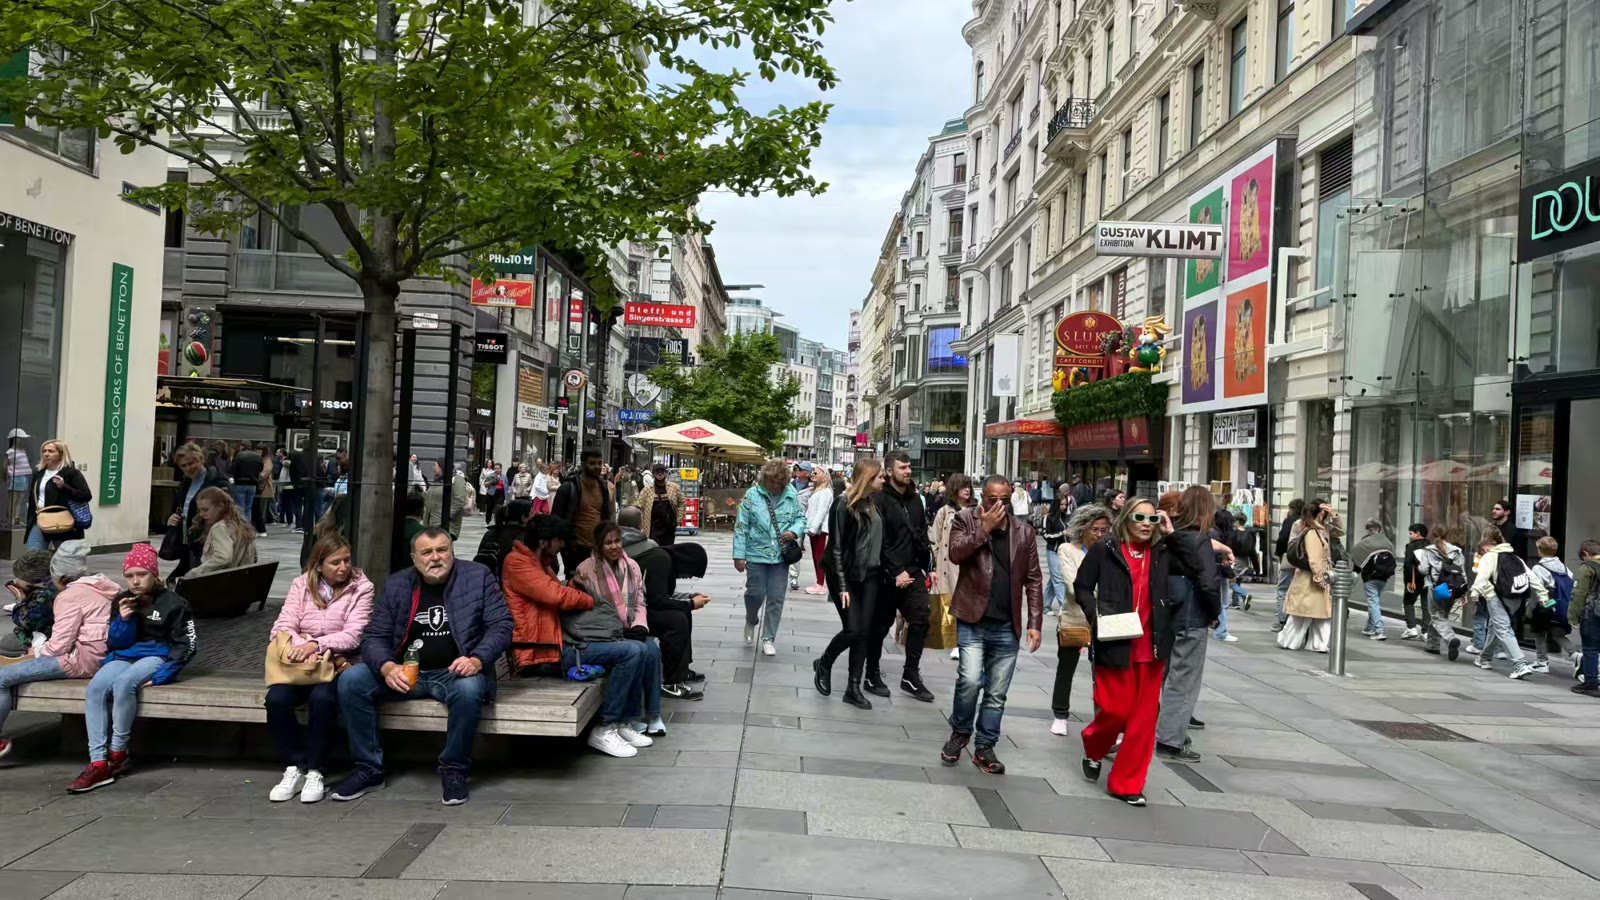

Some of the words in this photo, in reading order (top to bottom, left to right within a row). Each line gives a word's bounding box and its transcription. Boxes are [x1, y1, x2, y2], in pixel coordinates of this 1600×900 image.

[0, 213, 12, 229] OF
[15, 218, 71, 245] BENETTON
[1100, 227, 1145, 239] GUSTAV
[1146, 229, 1222, 251] KLIMT
[1100, 239, 1135, 248] EXHIBITION
[628, 313, 684, 324] Singerstrasse
[629, 306, 665, 315] Steffl
[1063, 330, 1104, 343] SLUK
[114, 354, 123, 375] OF
[111, 378, 122, 439] COLORS
[924, 436, 960, 445] NESPRESSO
[1213, 428, 1238, 445] KLIMT
[107, 443, 119, 499] UNITED
